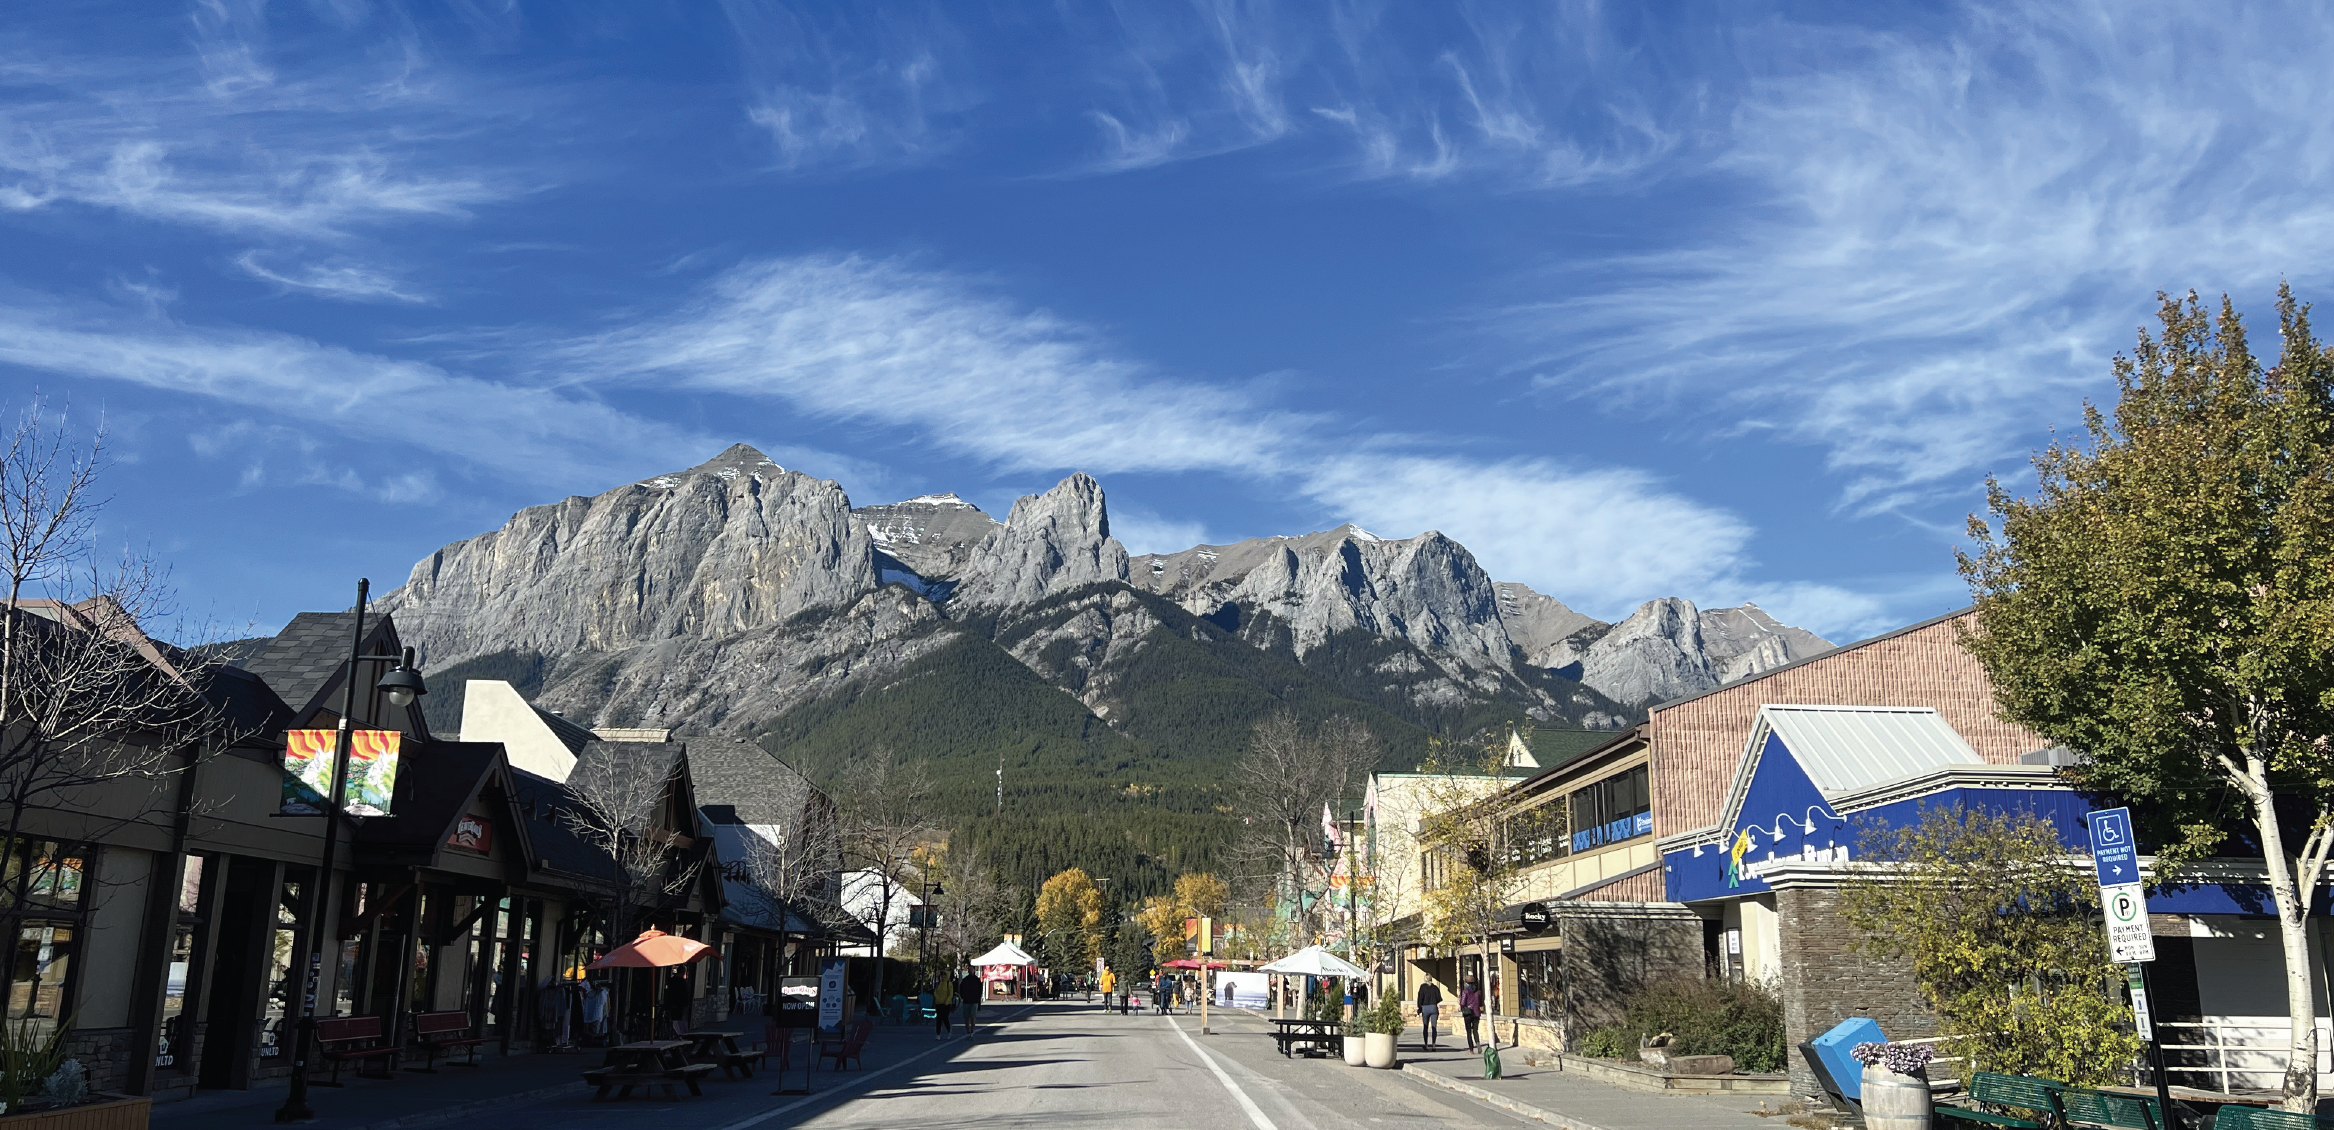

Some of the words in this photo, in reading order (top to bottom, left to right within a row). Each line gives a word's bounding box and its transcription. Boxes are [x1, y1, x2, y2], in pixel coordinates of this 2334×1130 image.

[2097, 847, 2119, 856] PAYMENT
[2102, 854, 2128, 863] REQUIRED
[2119, 898, 2129, 916] P
[2113, 924, 2143, 934] PAYMENT
[2113, 933, 2147, 943] REQUIRED
[261, 1047, 279, 1057] UNLTD
[155, 1055, 173, 1067] NLTD
